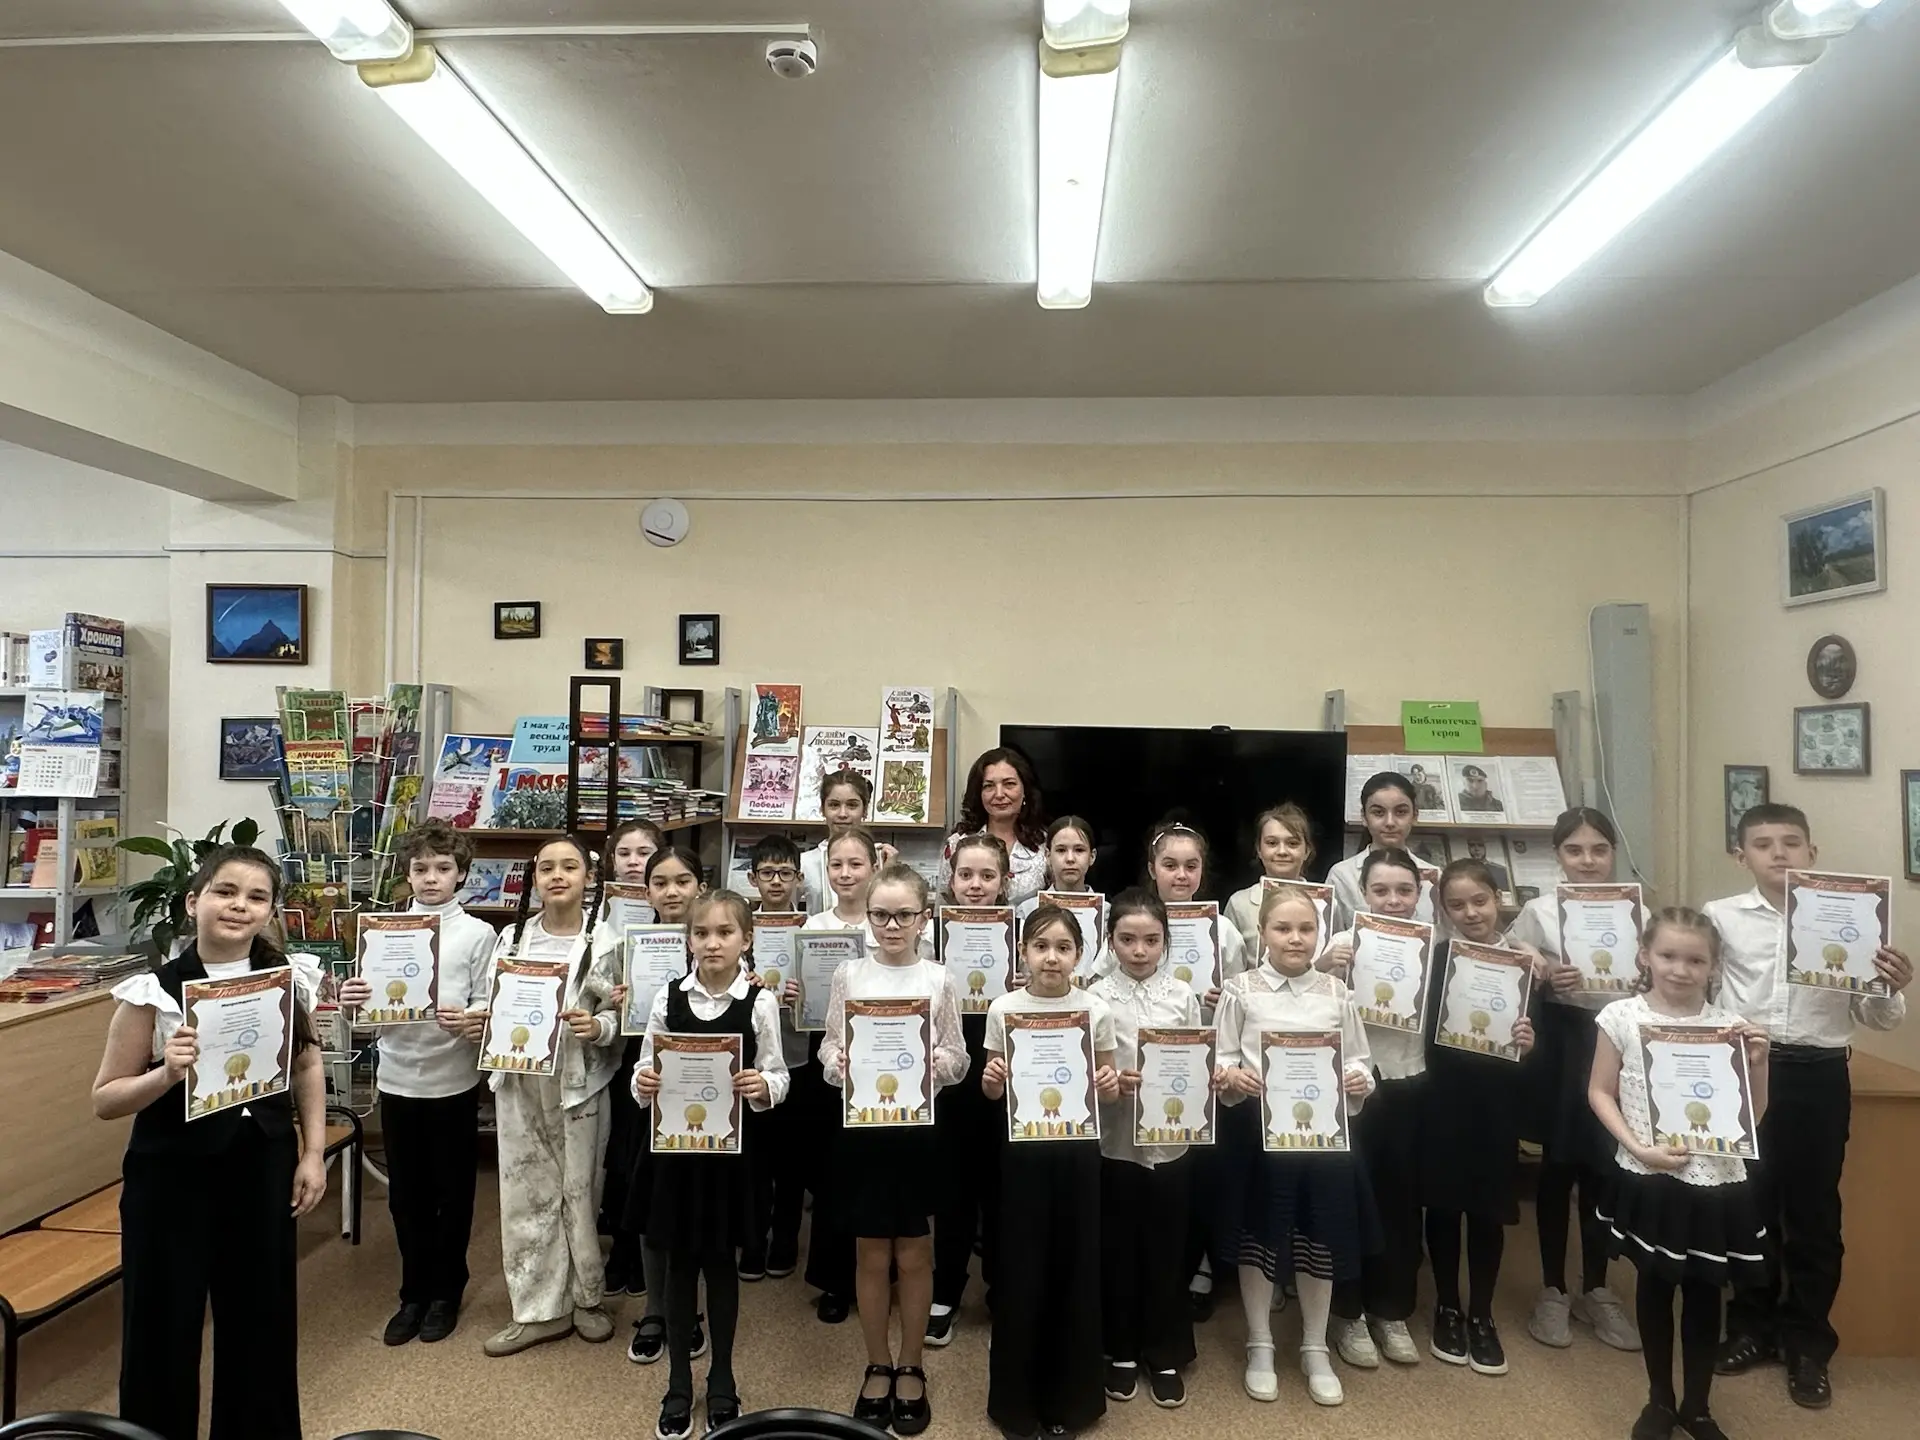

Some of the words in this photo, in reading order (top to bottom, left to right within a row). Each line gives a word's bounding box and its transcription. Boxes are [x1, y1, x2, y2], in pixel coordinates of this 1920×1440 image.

[1409, 715, 1477, 725] Библиотечка
[522, 721, 528, 729] 1
[532, 745, 561, 753] труда
[498, 768, 510, 791] 1
[516, 774, 569, 791] мая
[512, 863, 525, 871] ДЕ
[467, 878, 481, 886] АЯ
[506, 874, 522, 883] ВЕС
[504, 899, 519, 907] ТРУ
